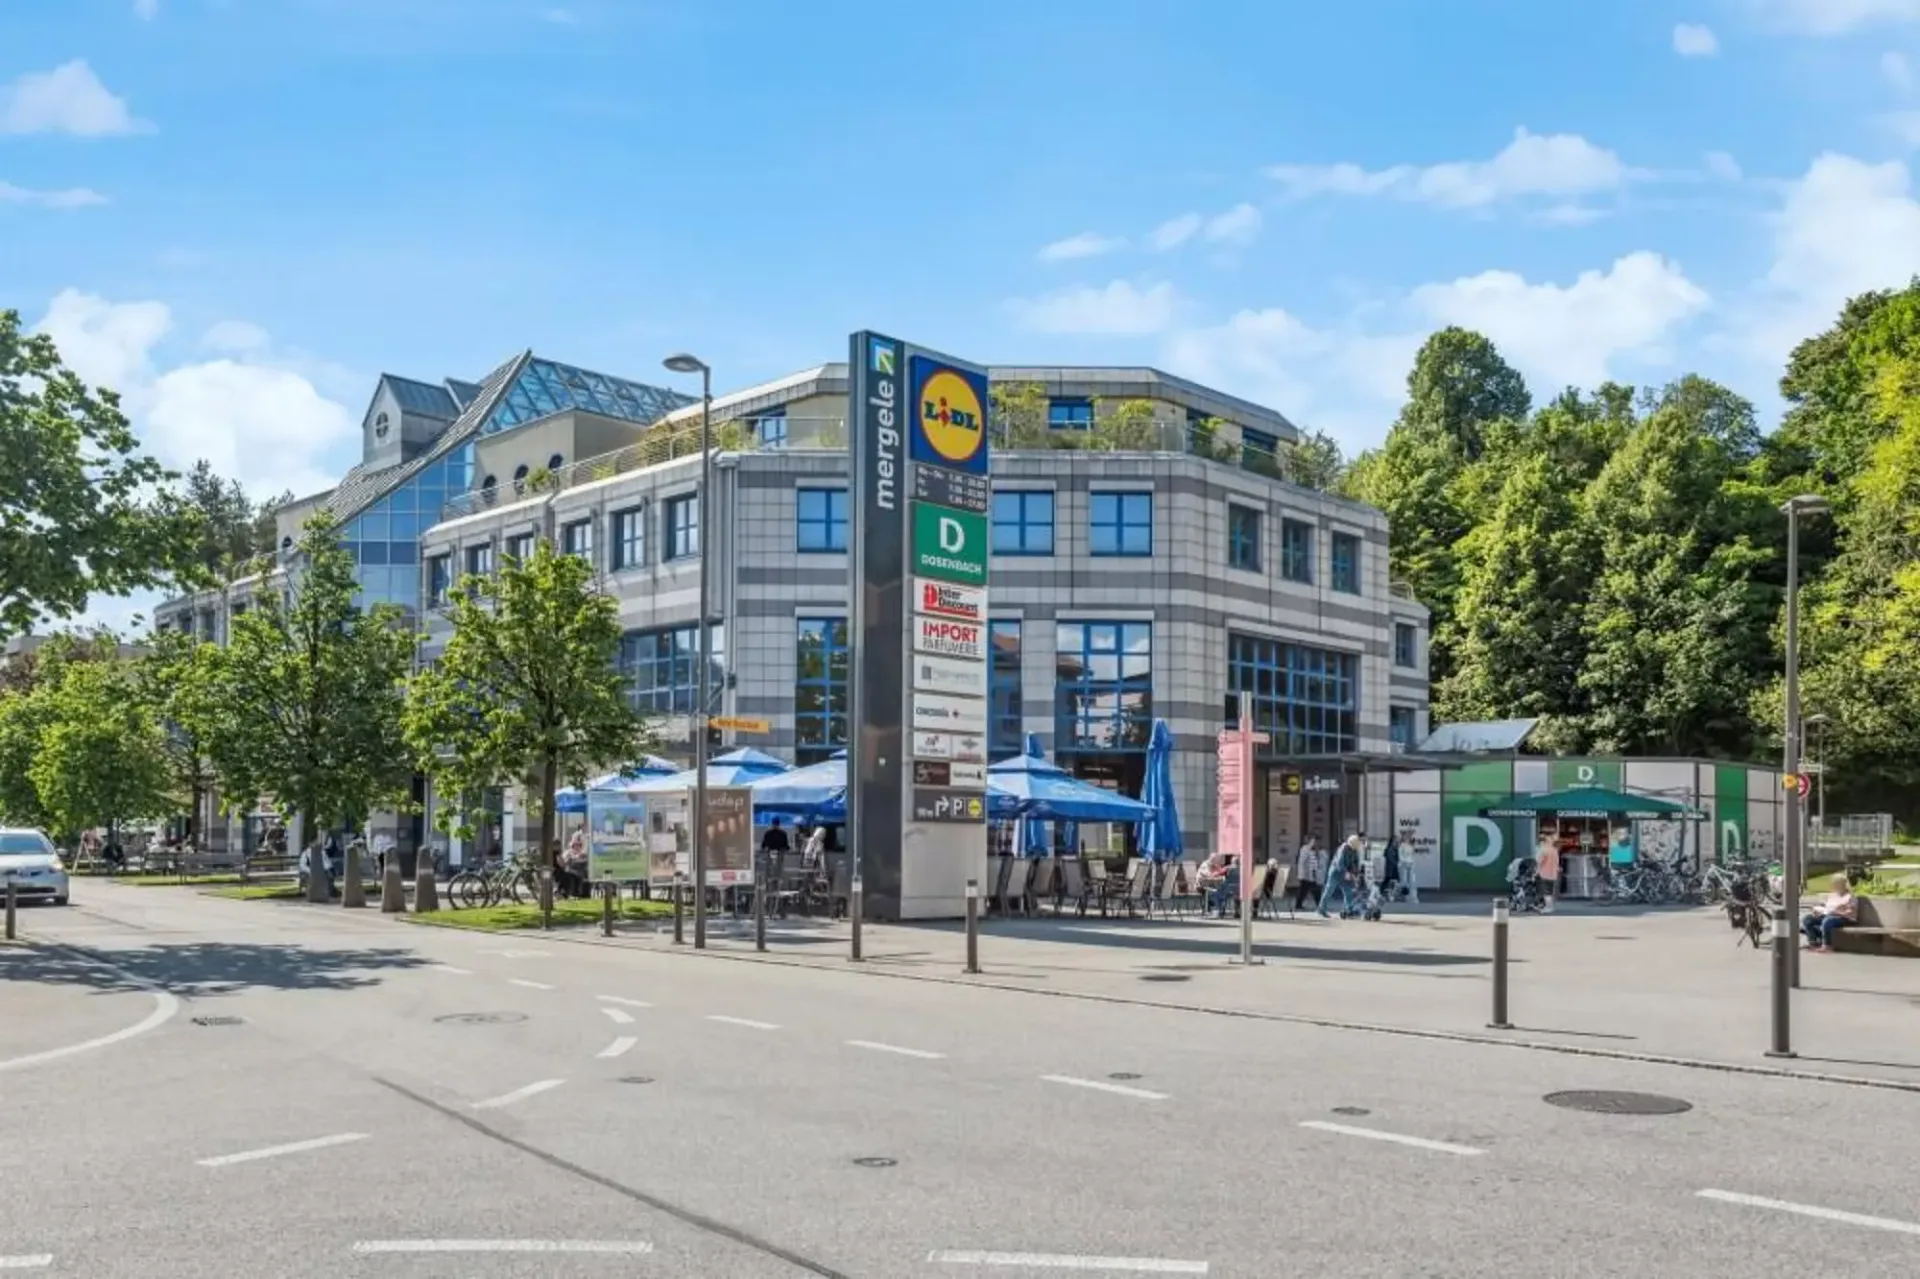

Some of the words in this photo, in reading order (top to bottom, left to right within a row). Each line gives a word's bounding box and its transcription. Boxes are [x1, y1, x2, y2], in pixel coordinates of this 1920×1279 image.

[869, 380, 899, 508] mergele
[939, 517, 965, 553] D
[921, 553, 982, 575] DOSENBACH
[922, 620, 978, 643] IMPORT
[1578, 765, 1594, 781] D
[1453, 816, 1504, 867] D
